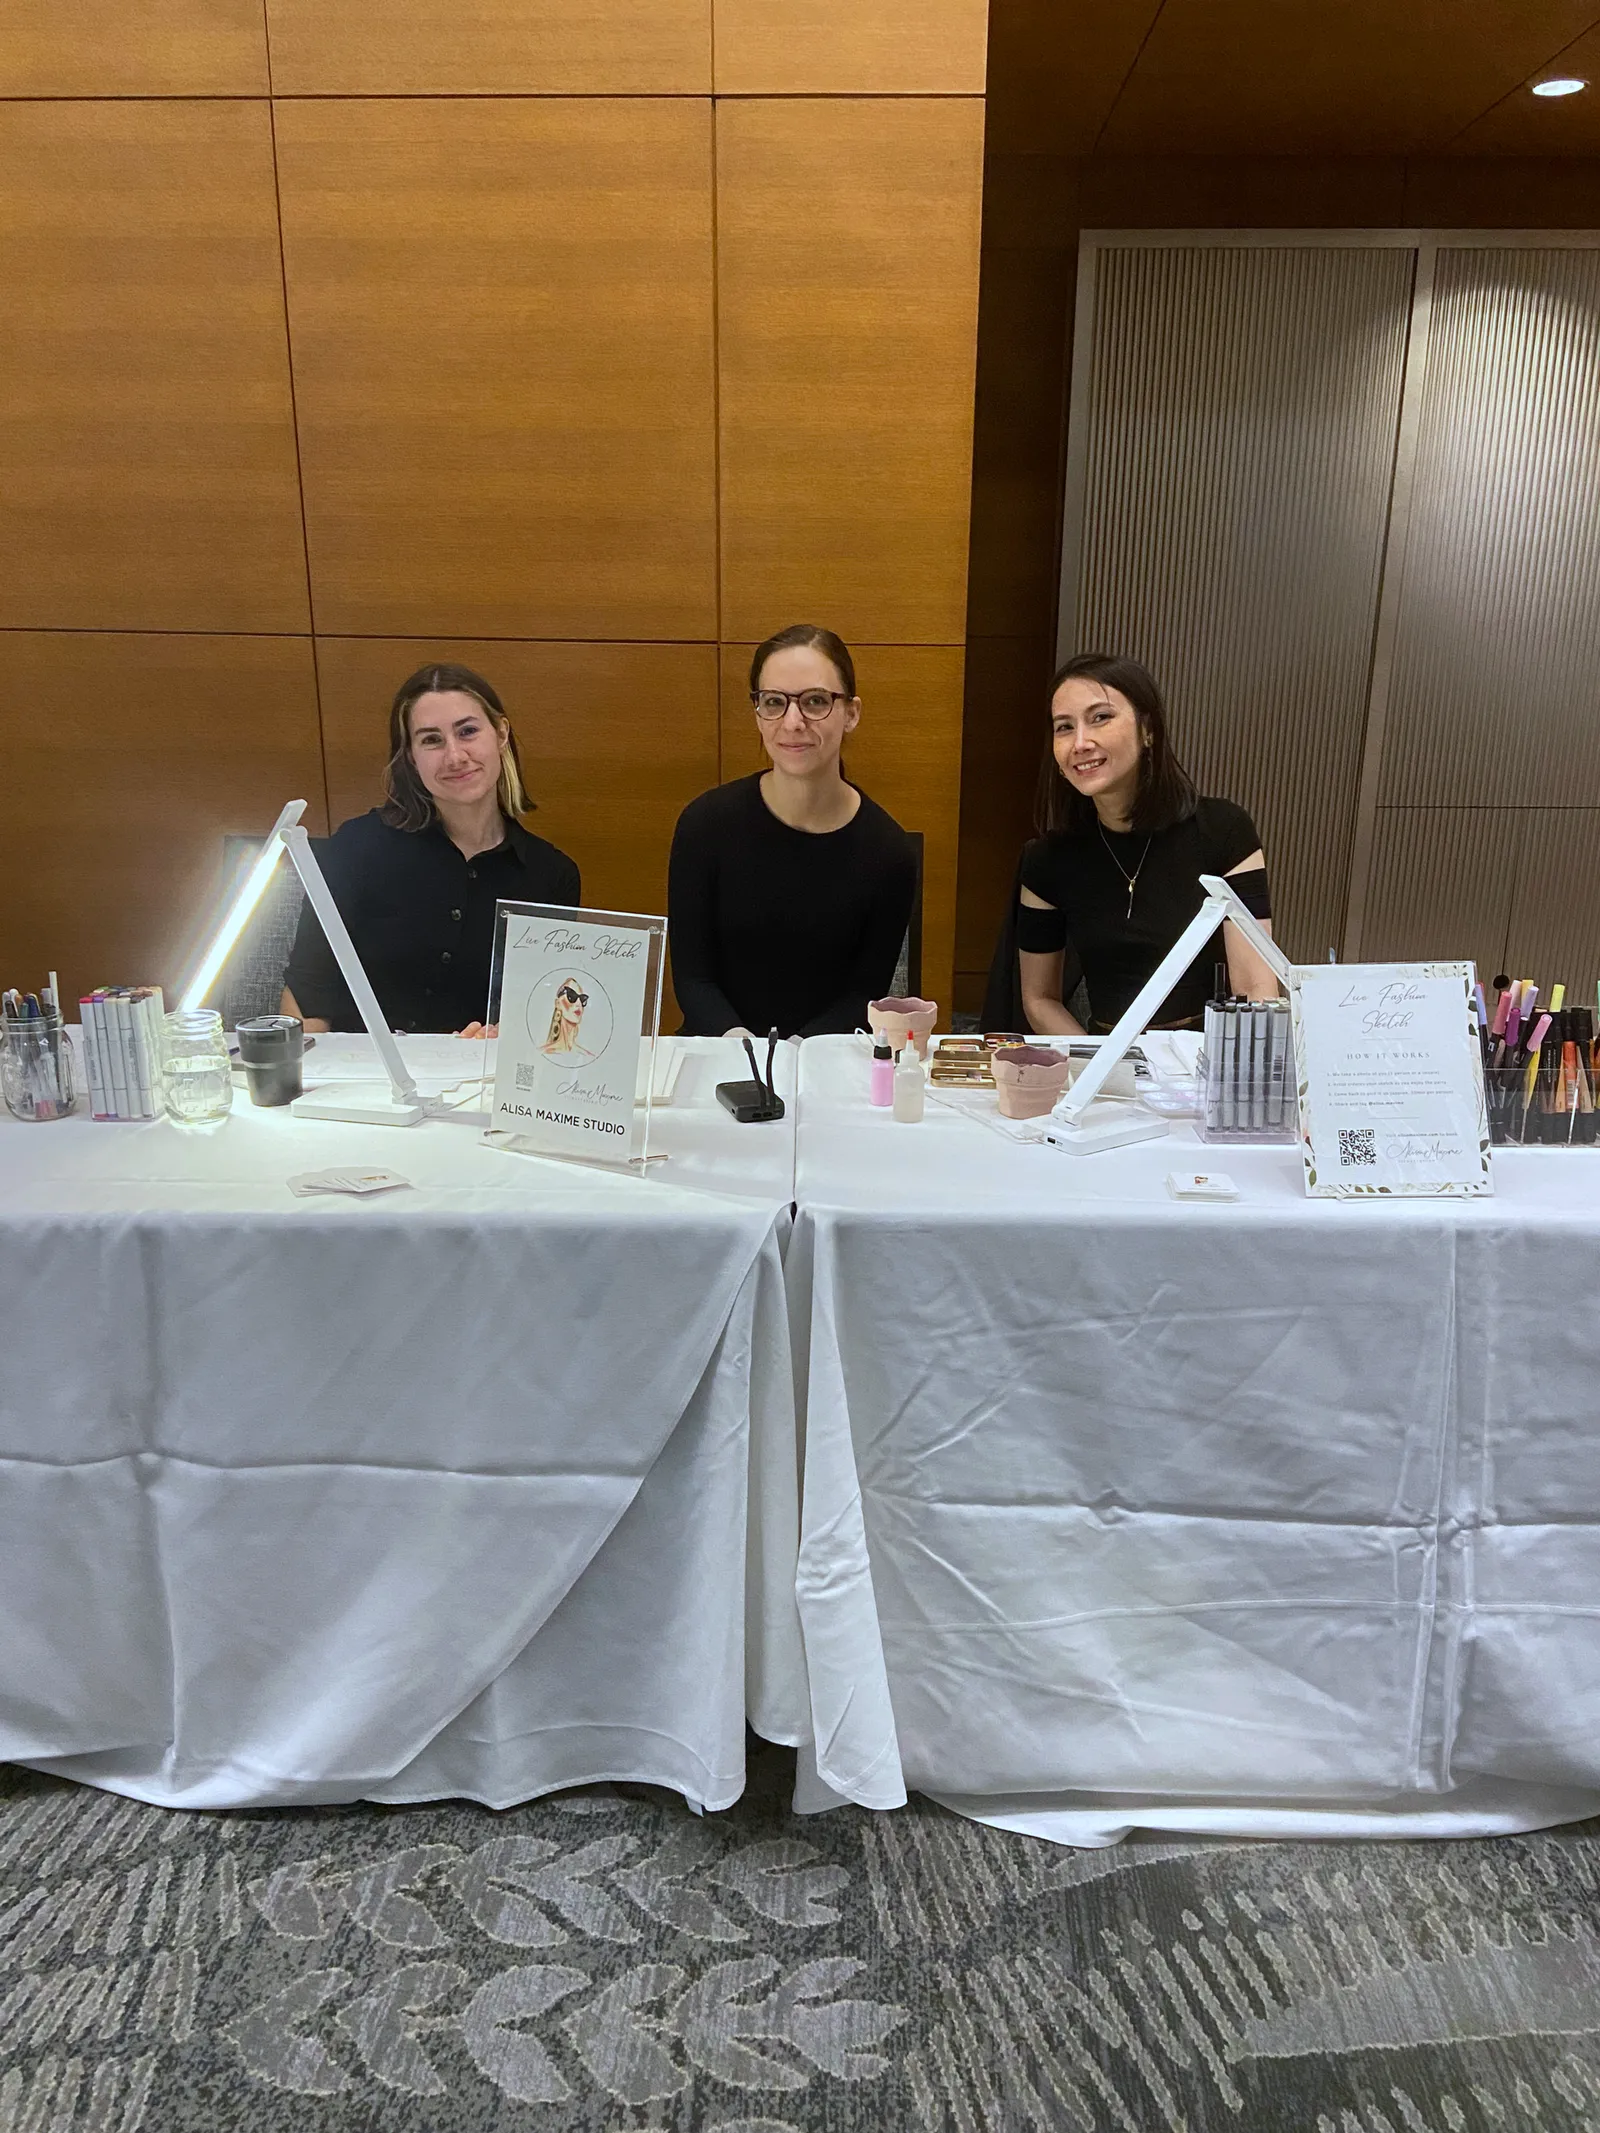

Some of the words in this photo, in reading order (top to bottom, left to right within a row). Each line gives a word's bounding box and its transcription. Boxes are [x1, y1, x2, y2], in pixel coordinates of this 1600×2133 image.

[543, 929, 586, 953] Fashion
[591, 935, 643, 960] Sketch
[1378, 982, 1427, 1008] Fashion
[1361, 1009, 1414, 1034] Sketch
[1347, 1052, 1371, 1060] HOW
[1392, 1051, 1431, 1059] WORKS
[499, 1102, 533, 1118] ALISA
[535, 1109, 581, 1128] MAXIME
[582, 1117, 626, 1136] STUDIO
